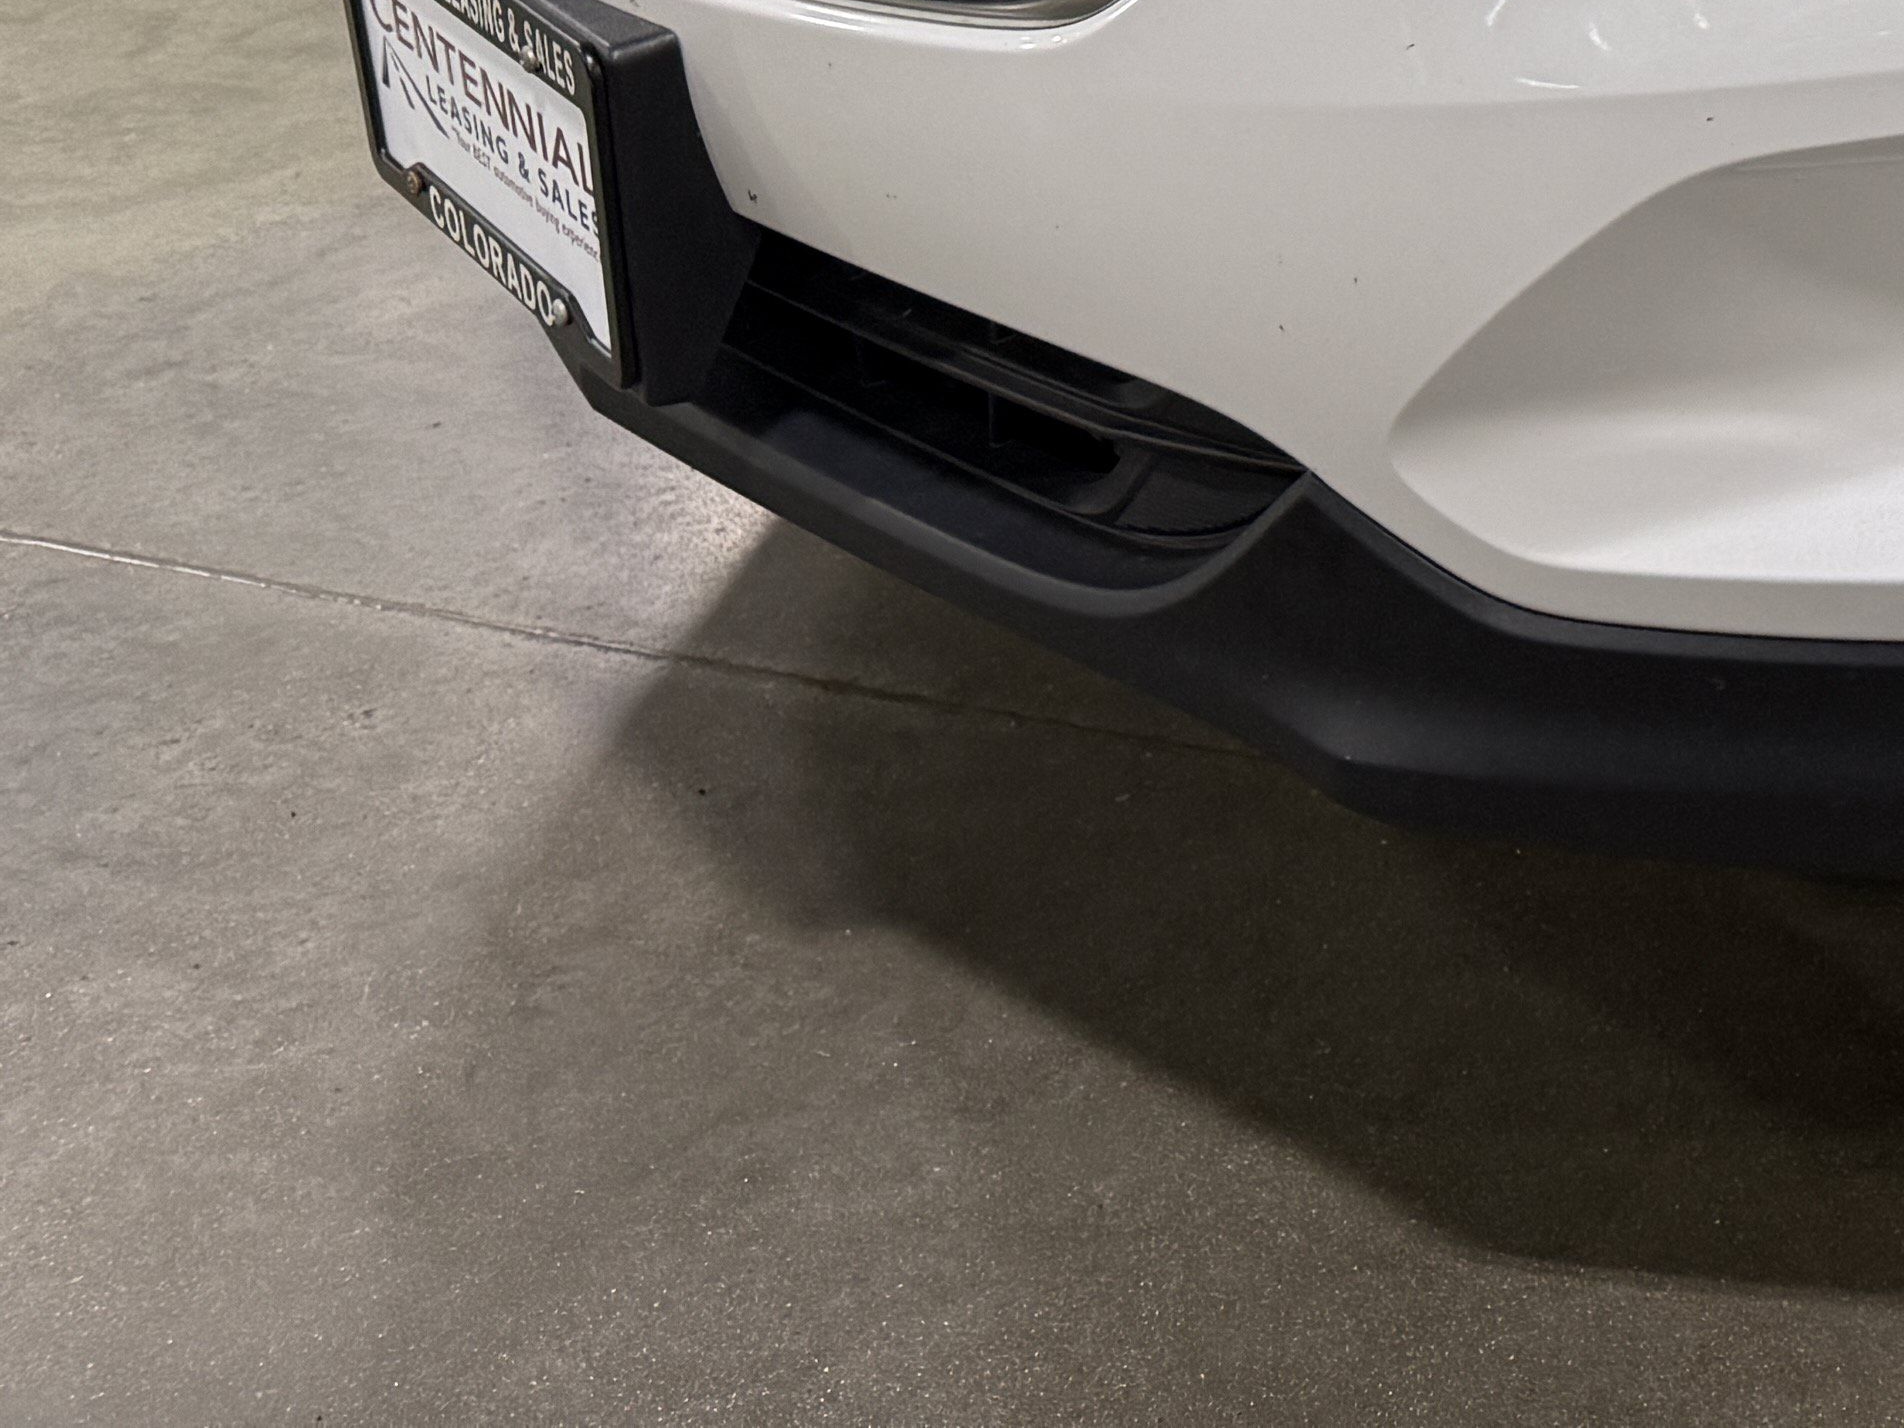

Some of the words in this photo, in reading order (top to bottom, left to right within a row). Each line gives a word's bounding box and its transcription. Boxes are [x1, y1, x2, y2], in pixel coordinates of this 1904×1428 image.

[507, 7, 521, 54] &
[523, 19, 576, 95] SALES
[425, 74, 509, 164] LEASING
[517, 151, 530, 183] &
[429, 185, 556, 327] COLORADO
